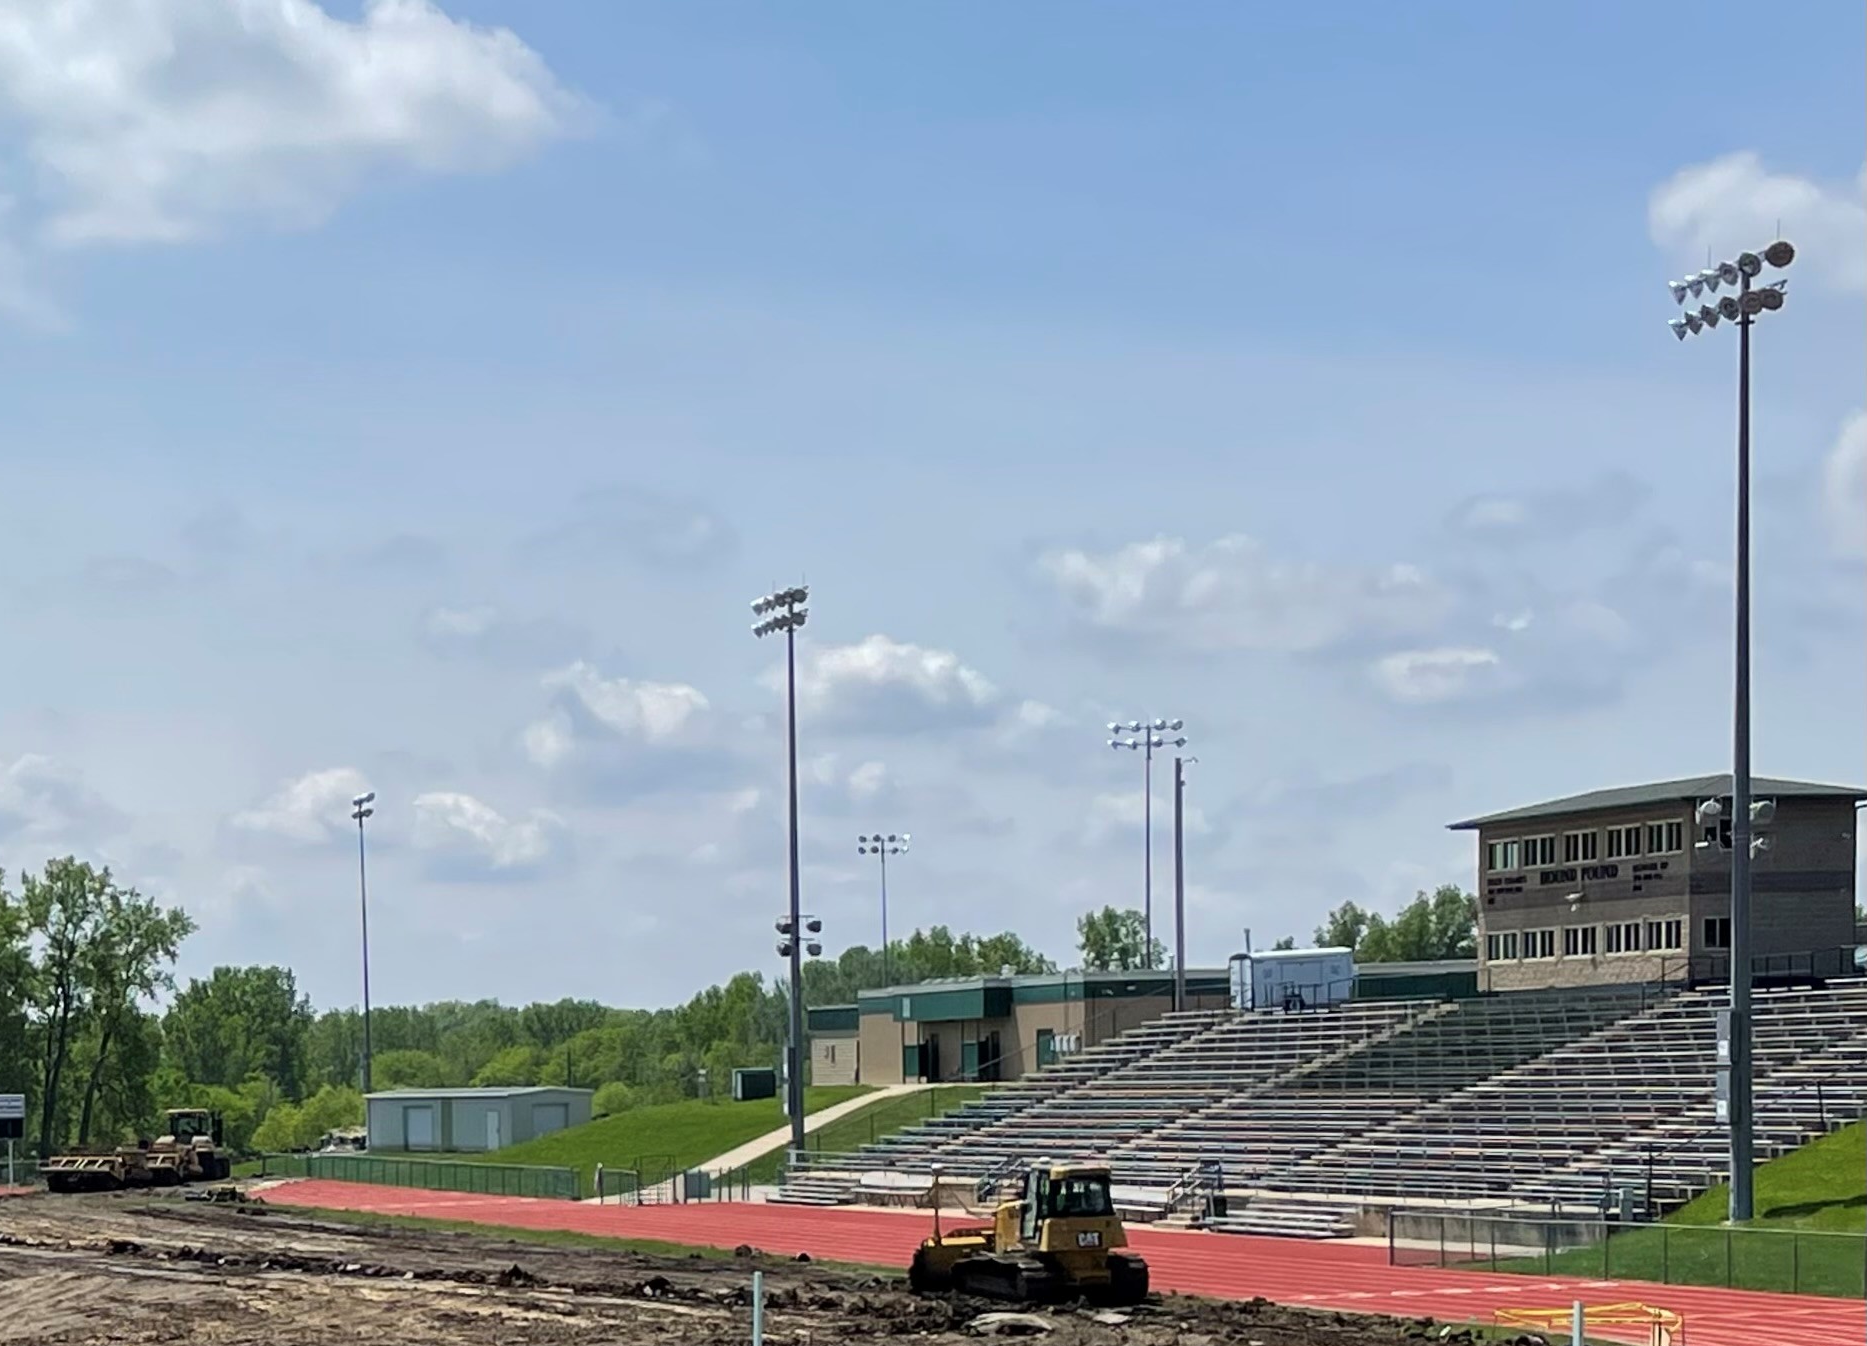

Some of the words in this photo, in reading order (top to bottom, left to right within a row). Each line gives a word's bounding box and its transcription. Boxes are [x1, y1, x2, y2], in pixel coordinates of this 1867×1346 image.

[1540, 869, 1577, 885] HOUND
[1581, 865, 1619, 881] POUND
[1078, 1232, 1099, 1247] CAT
